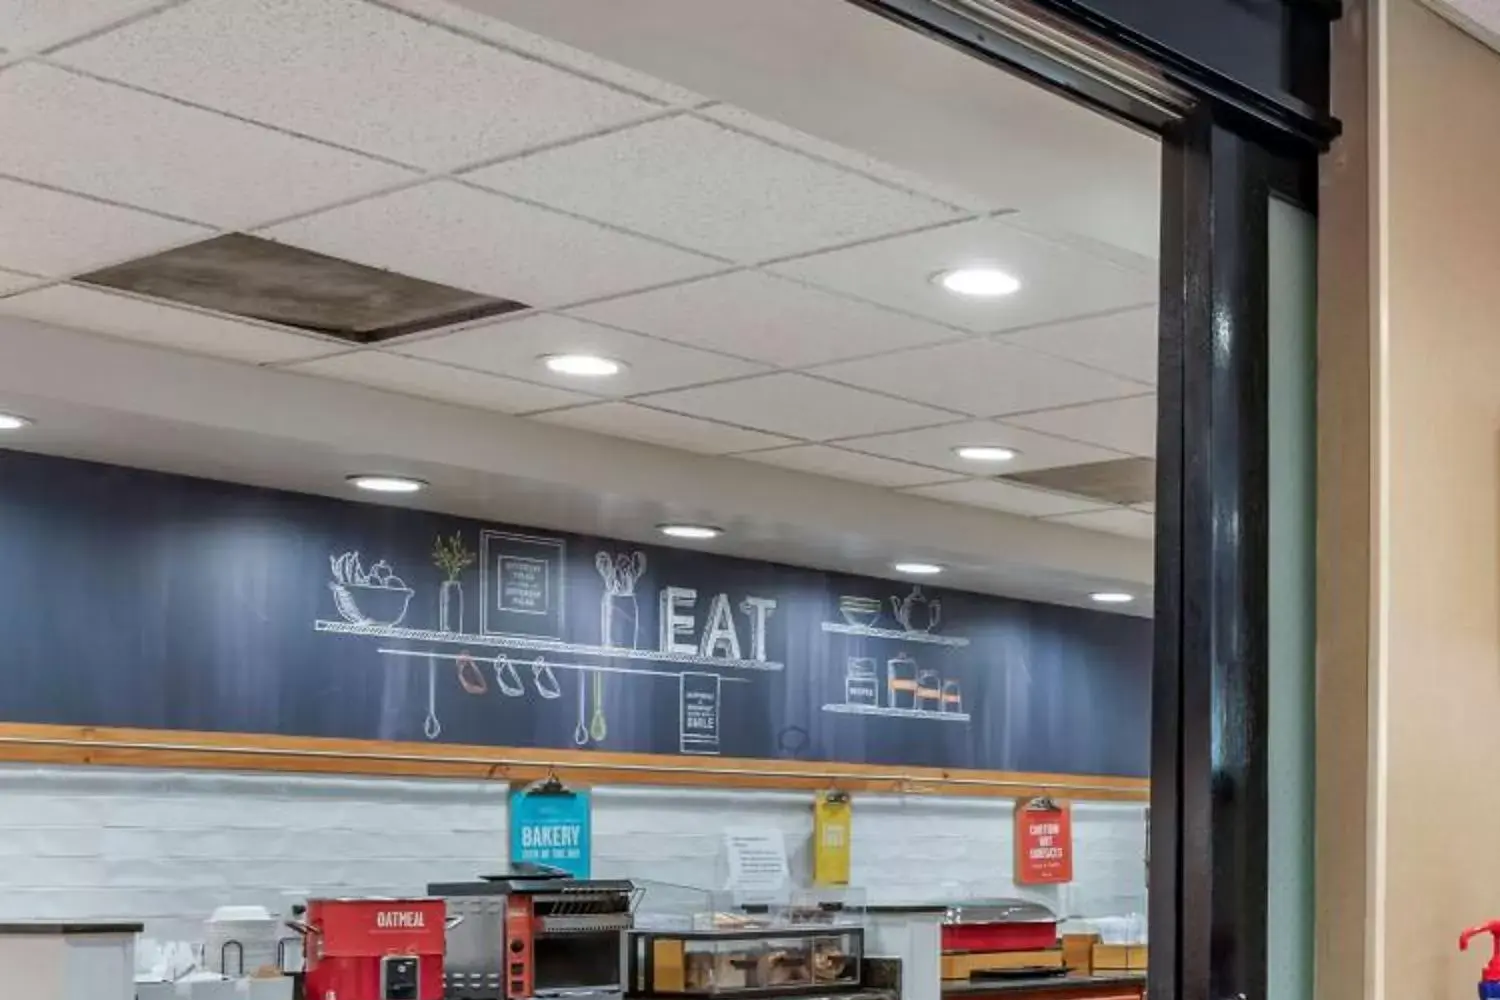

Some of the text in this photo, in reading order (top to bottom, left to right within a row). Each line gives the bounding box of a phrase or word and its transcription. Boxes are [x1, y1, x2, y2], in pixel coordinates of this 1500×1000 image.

[660, 586, 777, 663] EAT
[521, 824, 581, 848] BAKERY
[376, 911, 425, 928] OATMEAL
